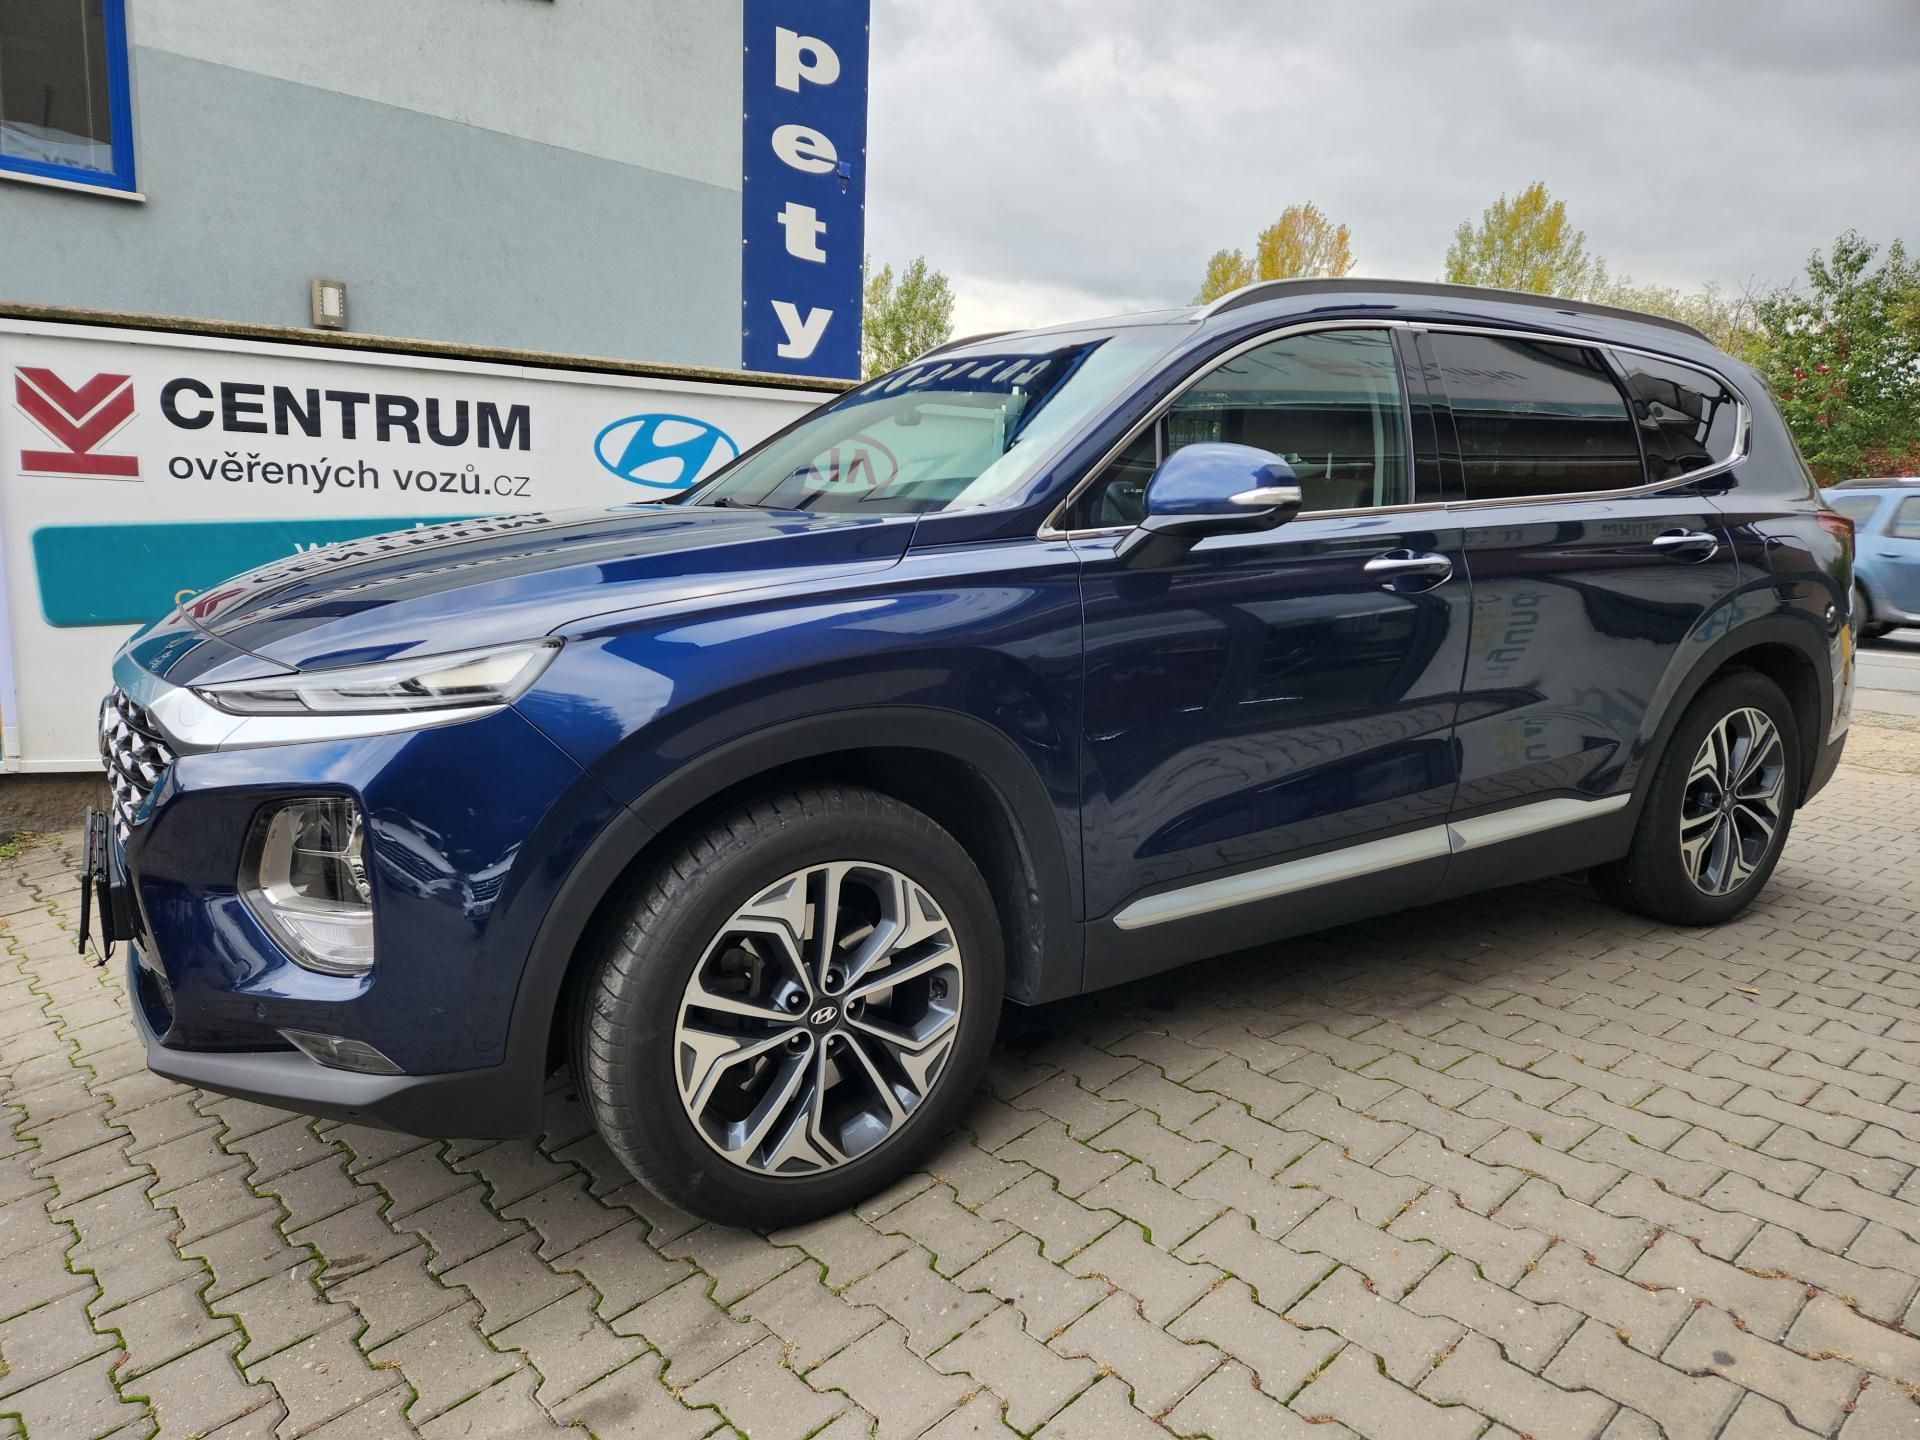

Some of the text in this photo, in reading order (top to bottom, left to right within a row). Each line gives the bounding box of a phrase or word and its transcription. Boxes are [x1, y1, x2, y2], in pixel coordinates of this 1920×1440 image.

[160, 377, 531, 451] CENTRUM
[168, 451, 531, 497] ověřených vozů.cz
